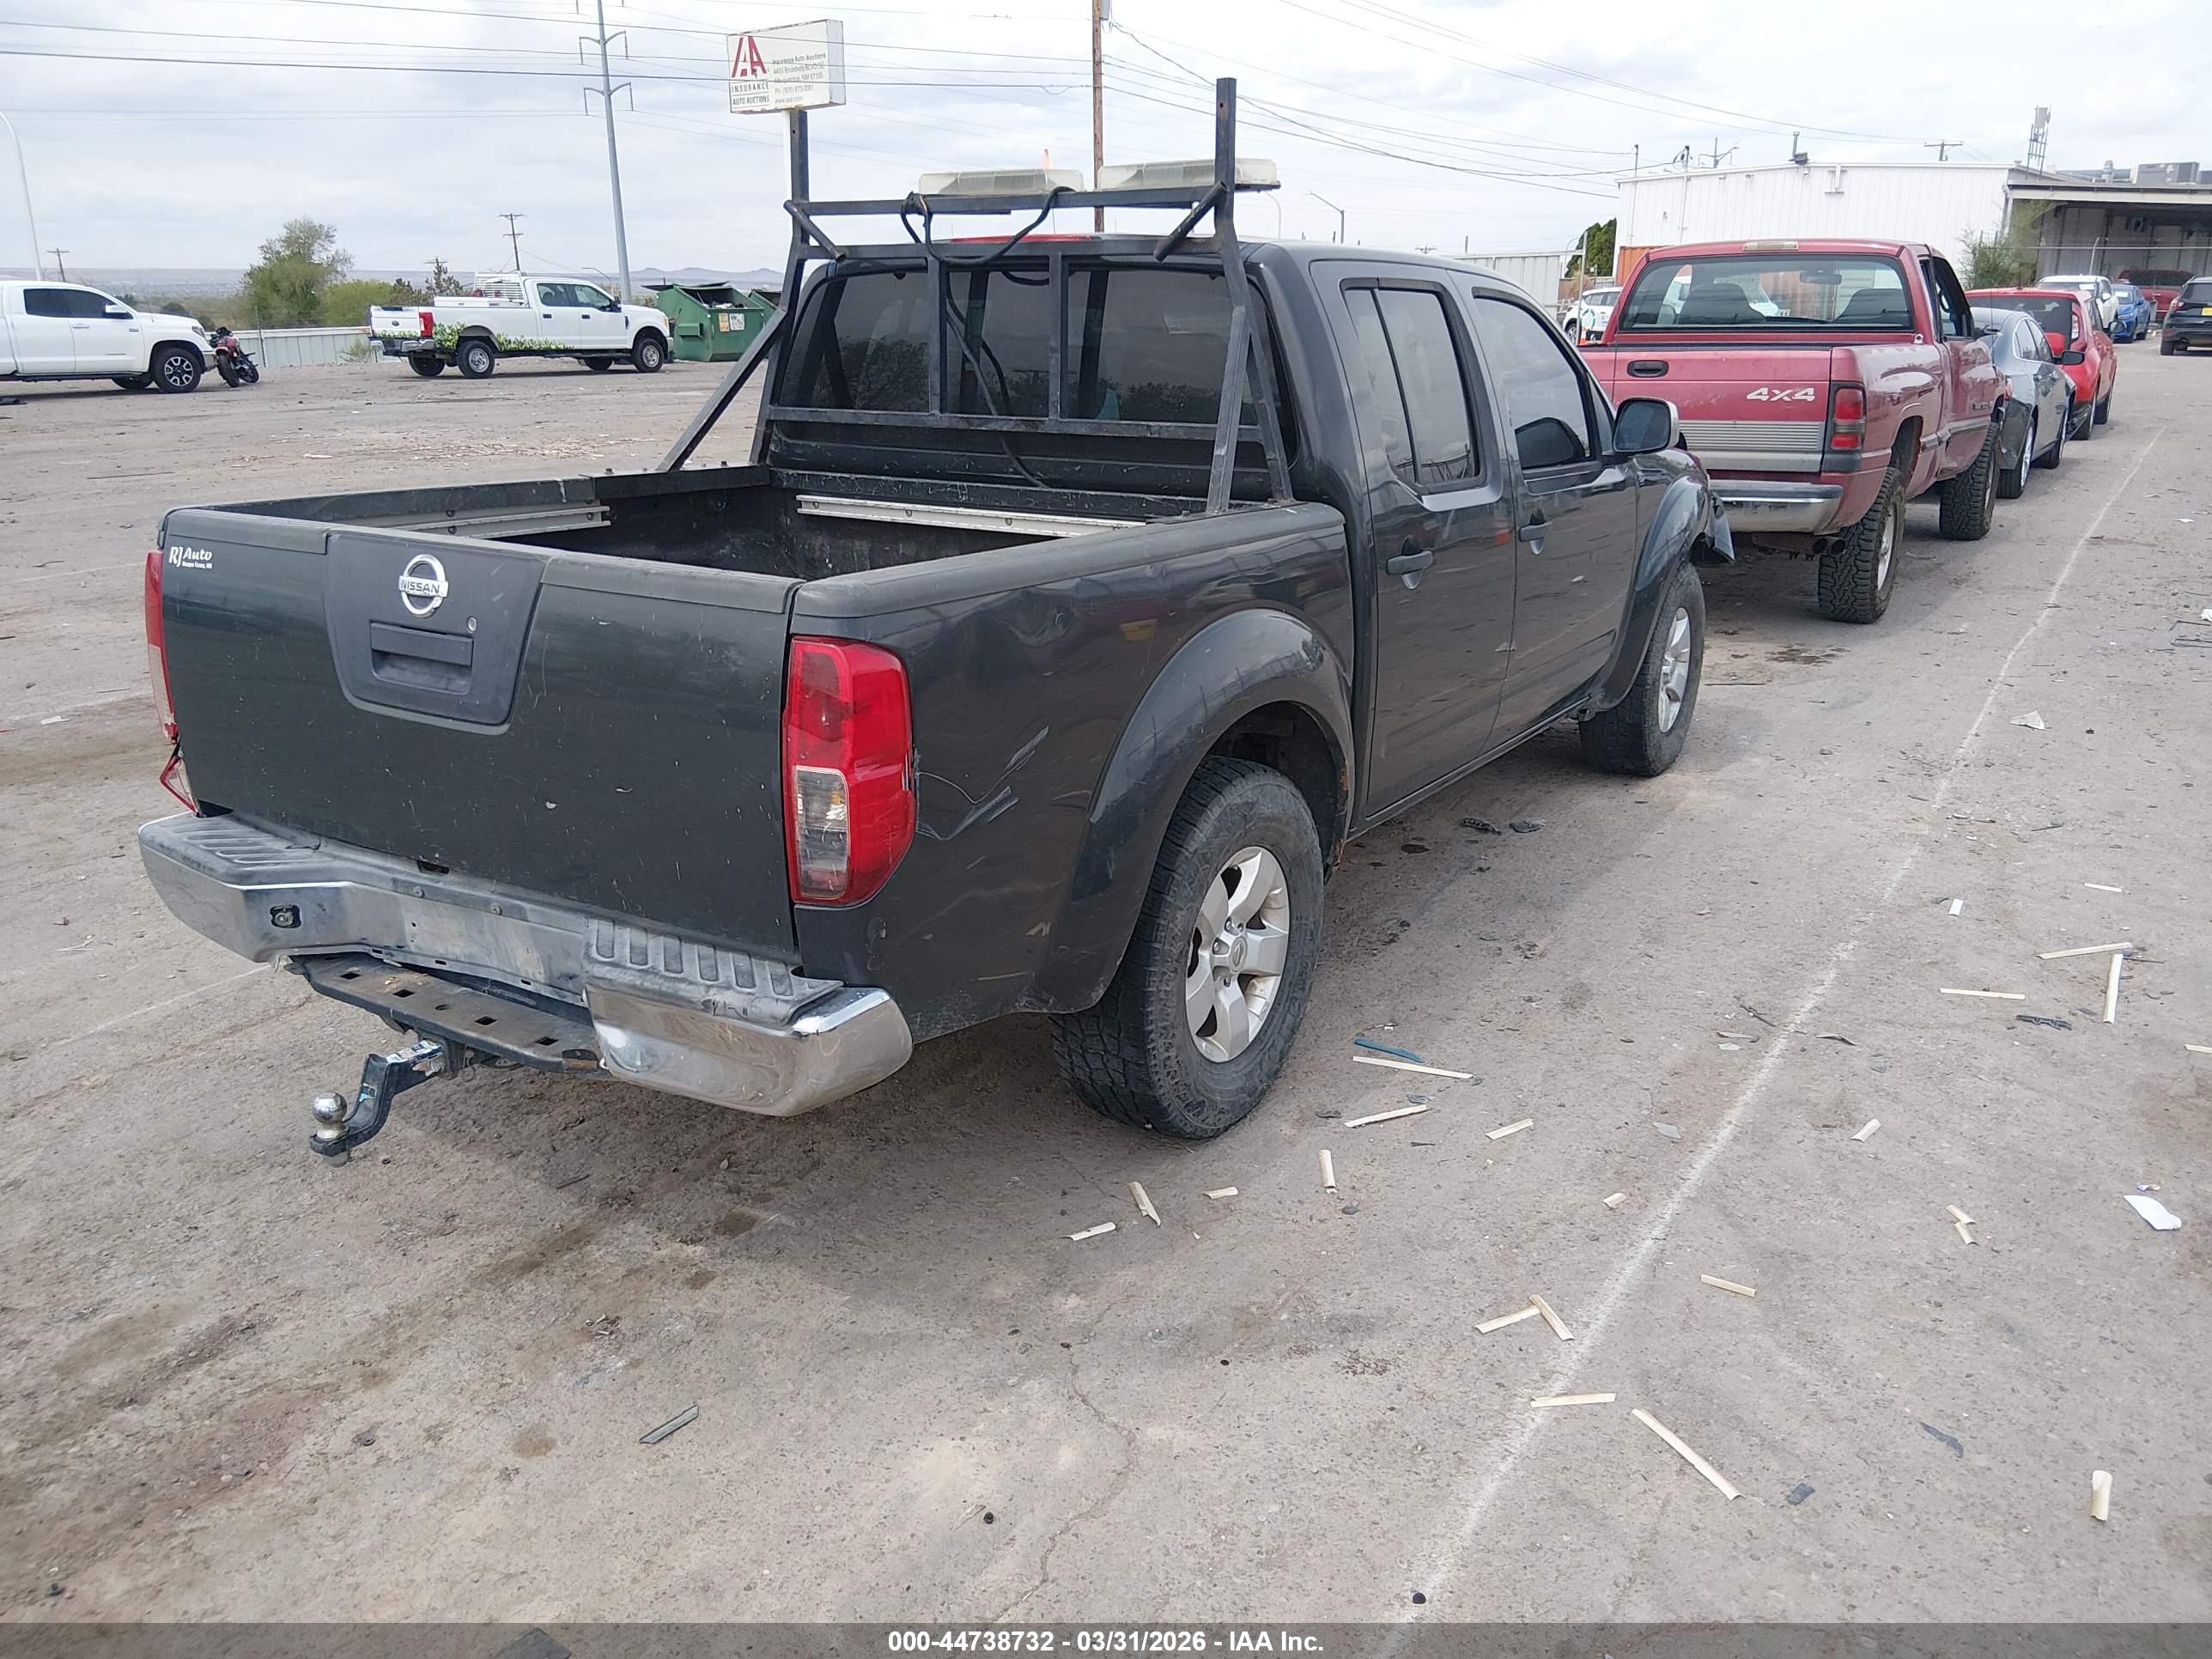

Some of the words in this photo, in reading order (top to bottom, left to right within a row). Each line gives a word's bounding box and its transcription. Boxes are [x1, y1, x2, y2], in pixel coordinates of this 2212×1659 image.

[732, 82, 769, 94] INSURANCE
[732, 97, 746, 106] AUTO
[746, 94, 769, 104] AUCTIONS
[182, 547, 213, 561] Auto
[401, 579, 440, 594] NISSAN
